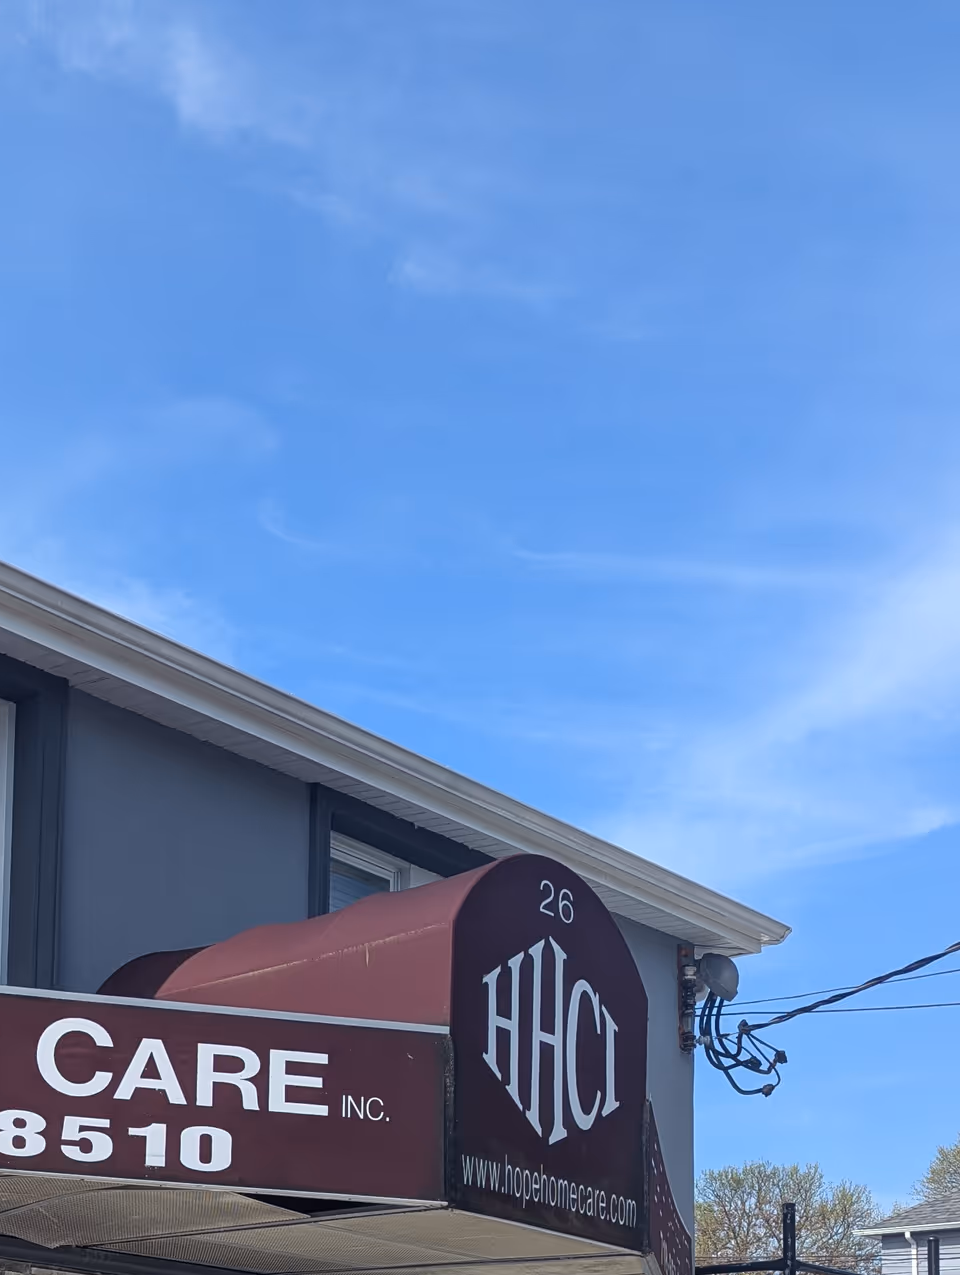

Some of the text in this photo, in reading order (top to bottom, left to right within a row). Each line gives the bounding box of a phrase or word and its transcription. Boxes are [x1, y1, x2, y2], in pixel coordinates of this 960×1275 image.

[539, 879, 574, 924] 26
[36, 1017, 329, 1117] CARE
[341, 1094, 391, 1122] INC.
[461, 1153, 637, 1228] www.hopehomecare.com
